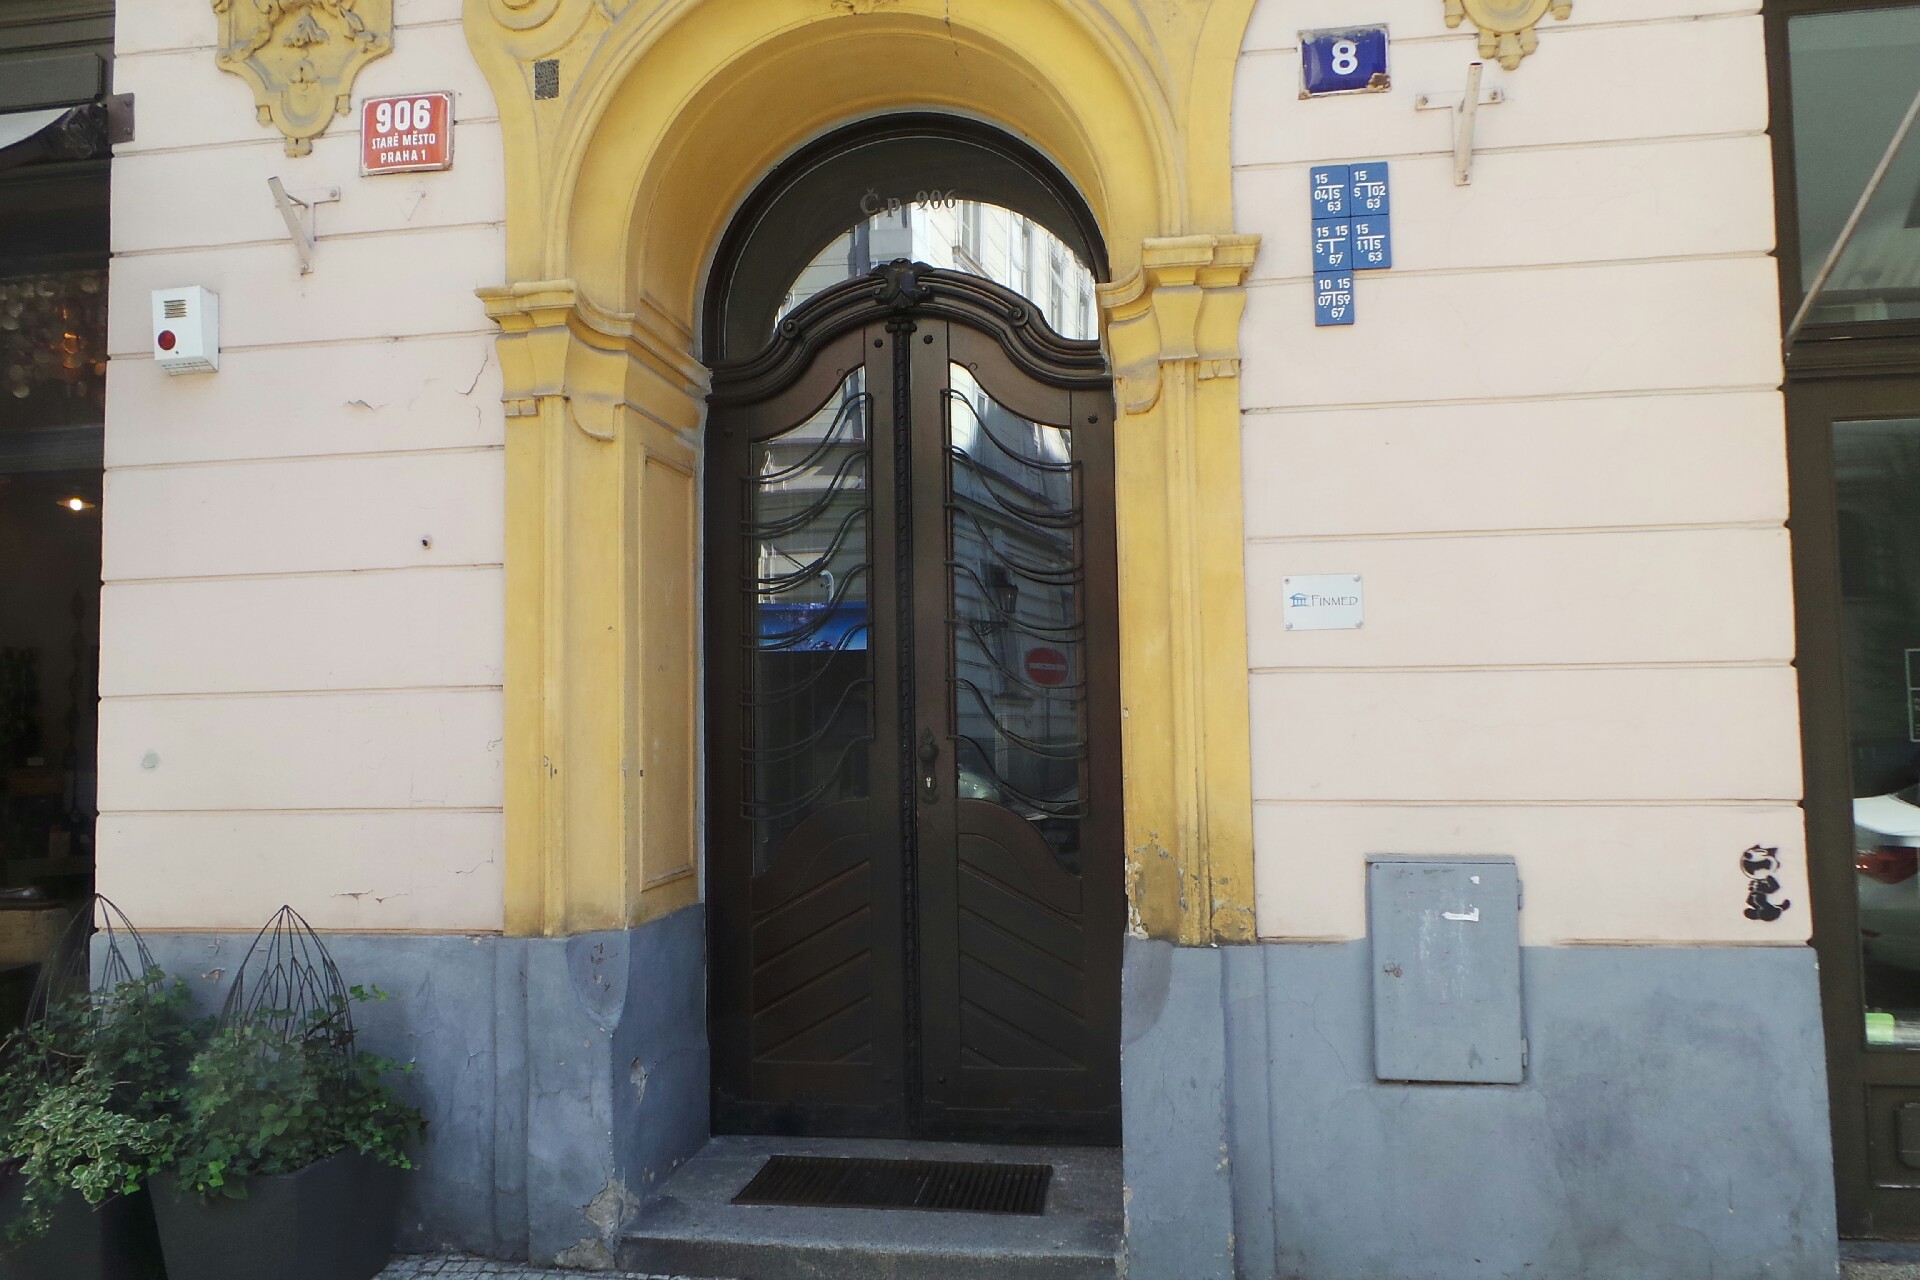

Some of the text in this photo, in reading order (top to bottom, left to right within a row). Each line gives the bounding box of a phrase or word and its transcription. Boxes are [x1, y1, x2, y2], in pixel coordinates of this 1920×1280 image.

[1331, 39, 1358, 75] 8
[376, 99, 431, 133] 906
[371, 130, 436, 149] STARÉ MĚSTO
[380, 149, 426, 164] PRAHA 1
[1315, 173, 1328, 184] 15
[1354, 170, 1367, 181] 15
[915, 189, 956, 211] 906
[1316, 225, 1348, 238] 15 15
[1355, 223, 1369, 235] 15
[1319, 278, 1350, 290] 10 15
